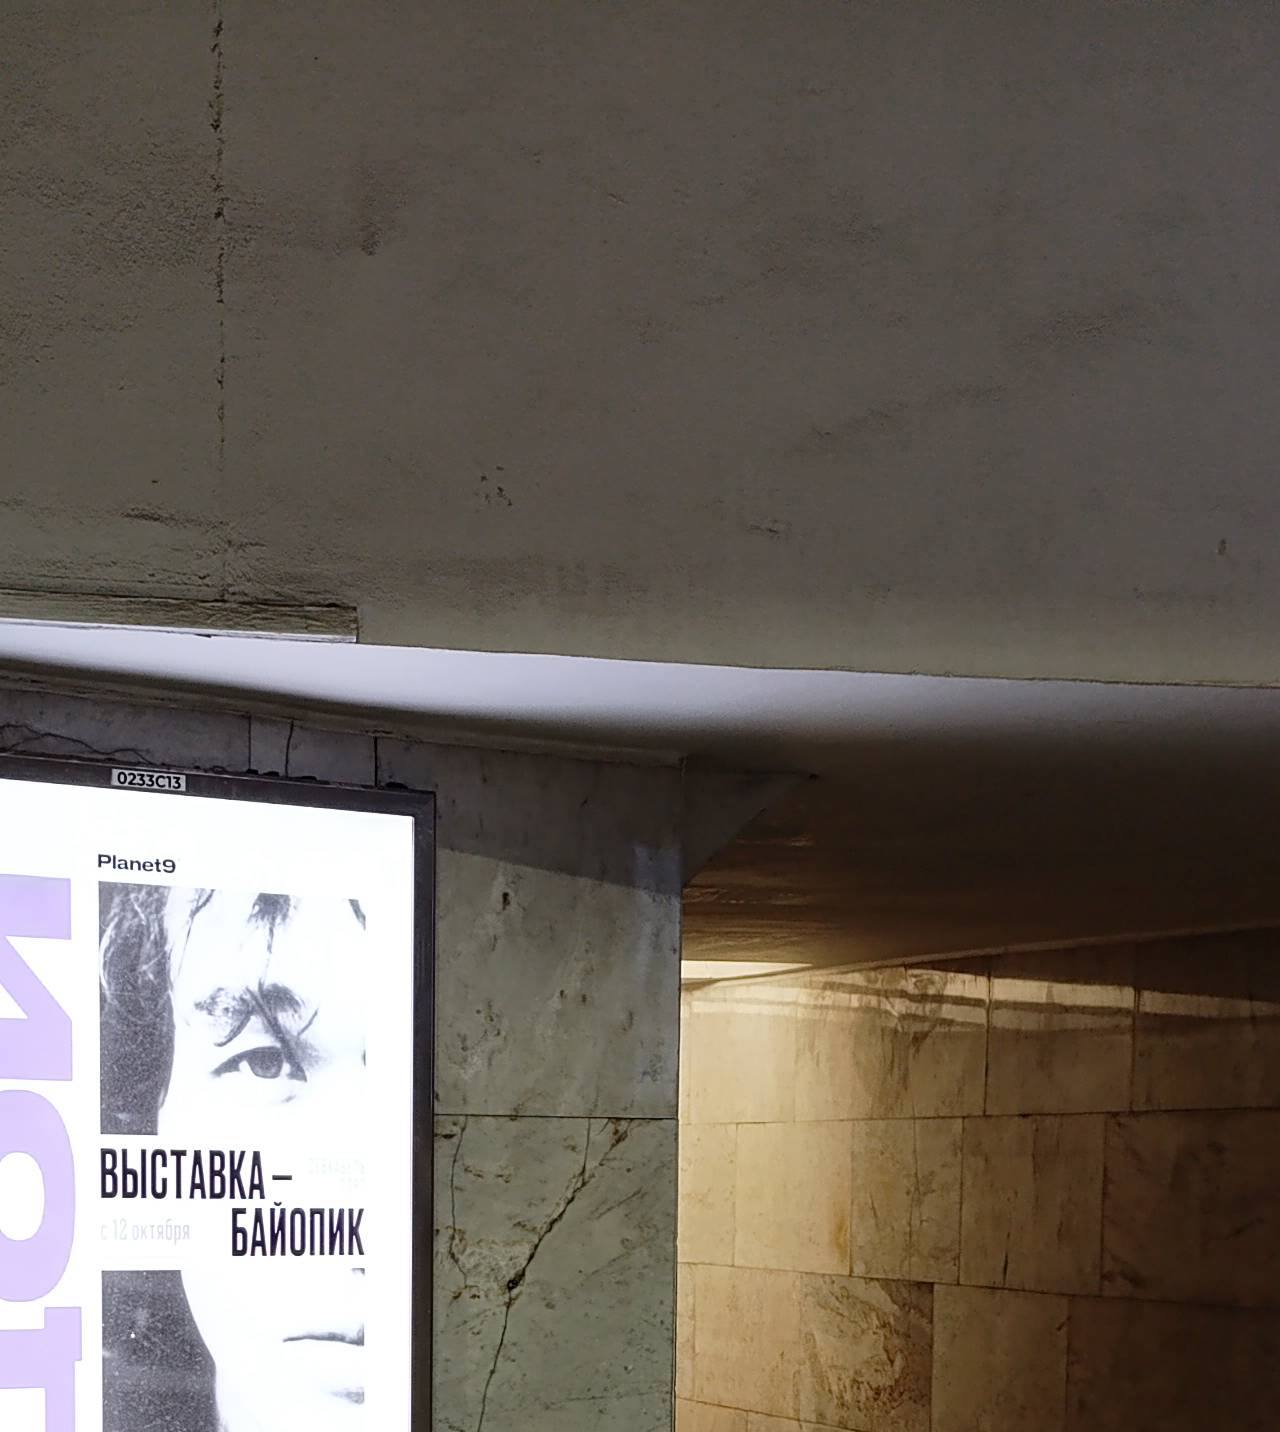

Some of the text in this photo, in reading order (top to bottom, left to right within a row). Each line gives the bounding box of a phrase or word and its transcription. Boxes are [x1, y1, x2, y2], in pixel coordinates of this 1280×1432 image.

[116, 771, 183, 791] 0233C13
[97, 854, 177, 875] Planet9
[112, 1218, 128, 1241] 12
[131, 1217, 191, 1247] октября
[230, 1201, 366, 1257] БАЙОПИК
